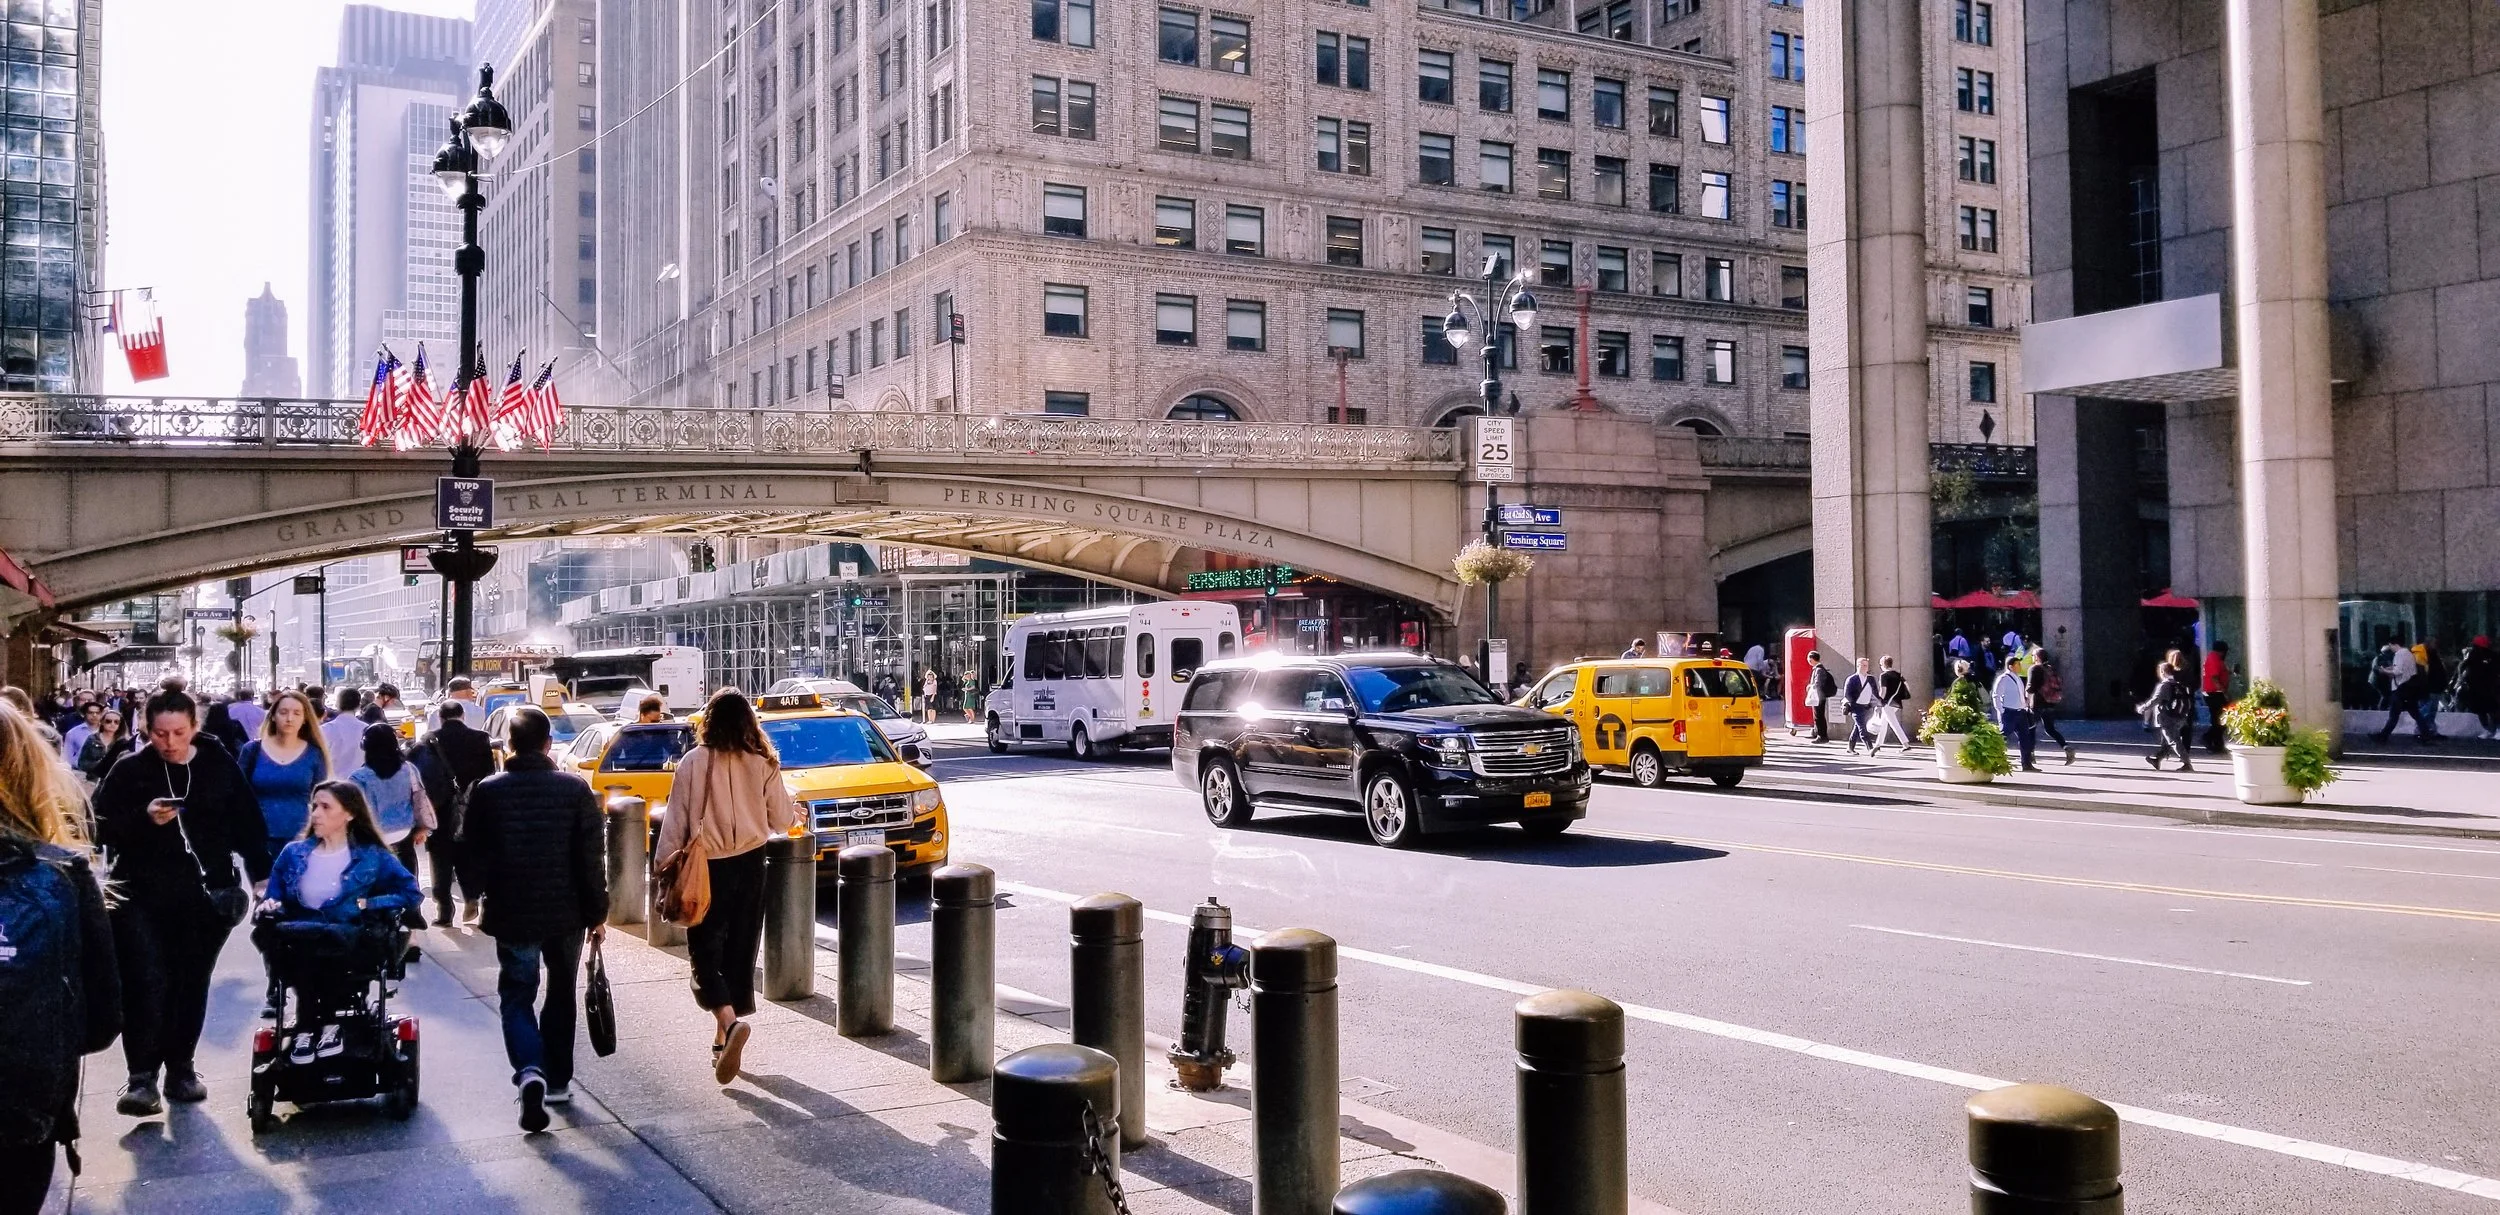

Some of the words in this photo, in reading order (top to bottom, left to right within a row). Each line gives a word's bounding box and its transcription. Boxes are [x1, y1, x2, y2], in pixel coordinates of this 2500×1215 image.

[1482, 443, 1509, 460] 25
[454, 481, 480, 490] NYPD
[277, 508, 405, 542] GRAND
[612, 484, 777, 503] TERMINAL
[448, 505, 484, 516] Security
[1535, 512, 1551, 521] Ave
[449, 514, 483, 522] Camera
[943, 487, 1076, 513] PERSHING
[1094, 503, 1188, 530] SQUARE
[1204, 522, 1275, 549] PLAZA
[1506, 534, 1538, 546] Pershing
[1539, 535, 1564, 546] Square
[1188, 570, 1241, 590] PERSHING
[485, 659, 502, 671] YORK
[780, 695, 800, 706] 4A76
[1602, 723, 1620, 750] T
